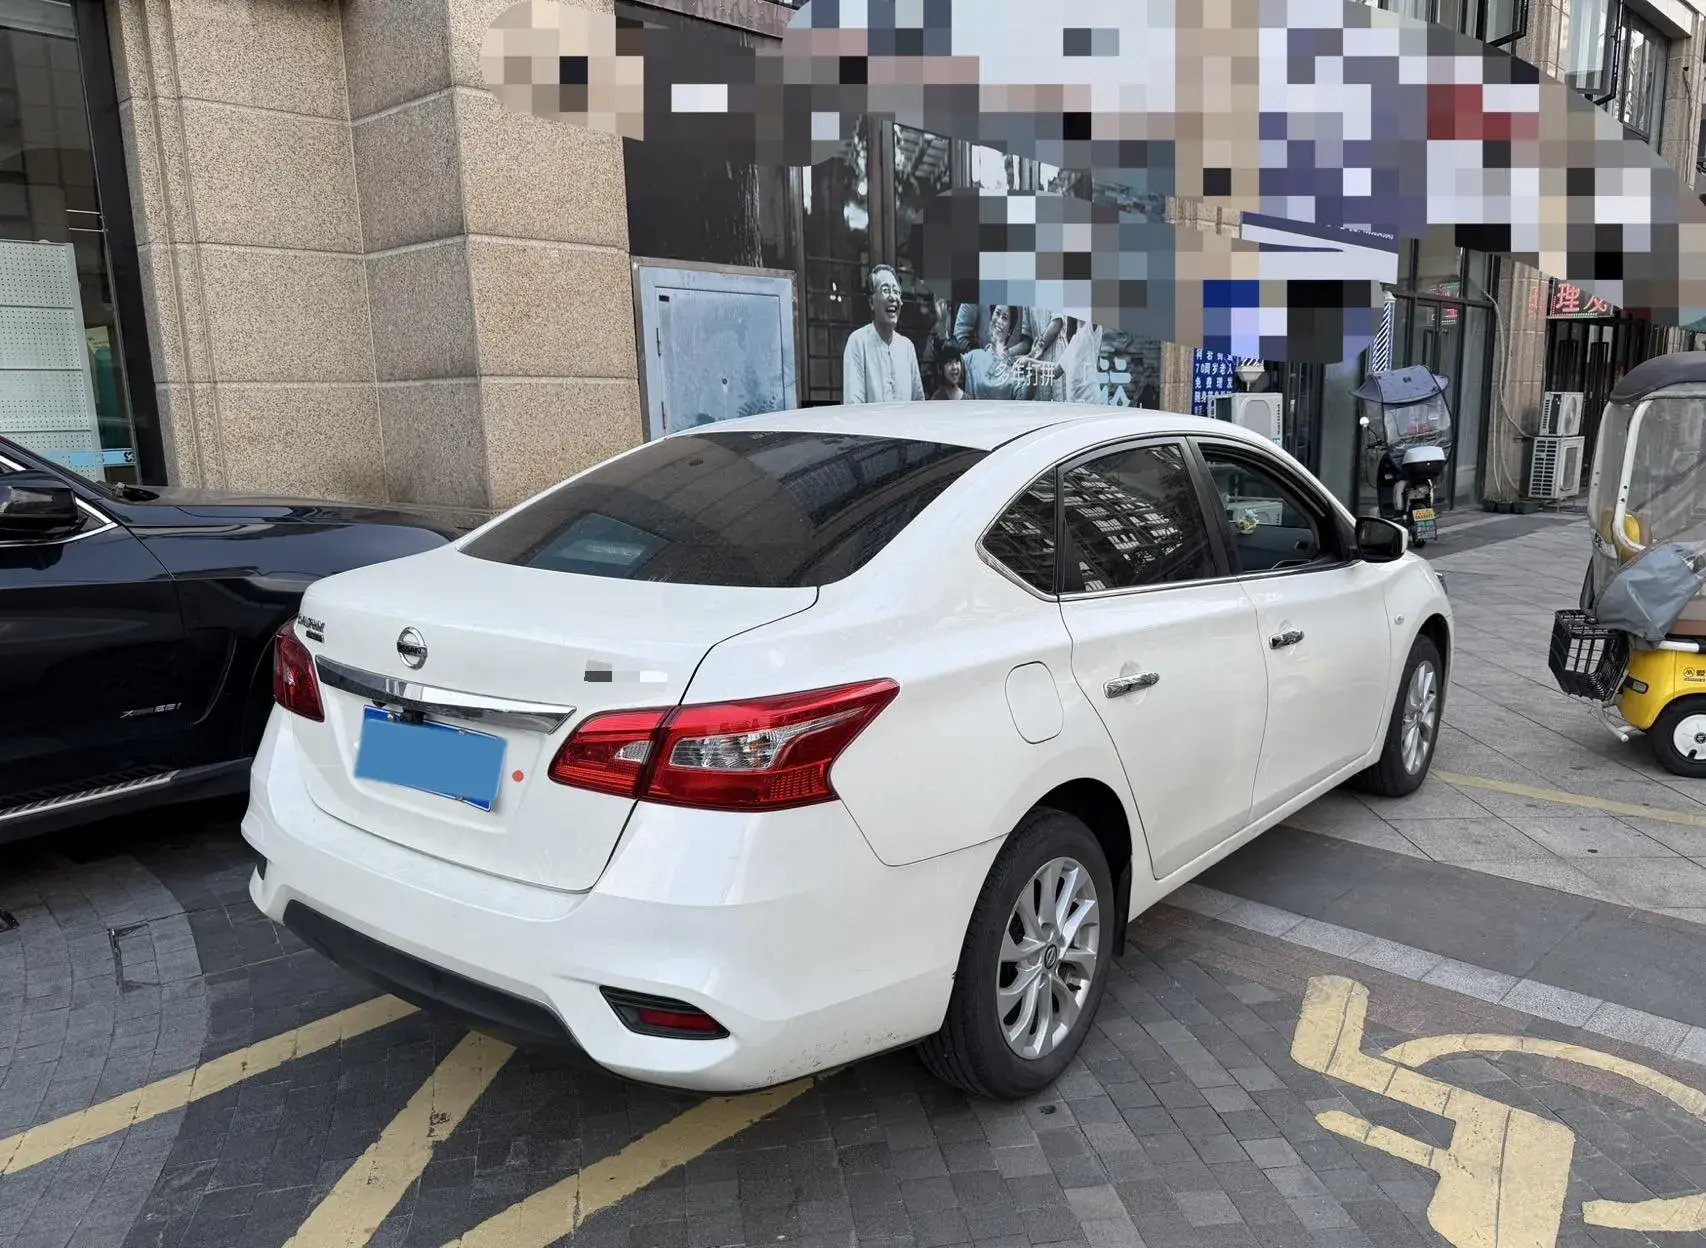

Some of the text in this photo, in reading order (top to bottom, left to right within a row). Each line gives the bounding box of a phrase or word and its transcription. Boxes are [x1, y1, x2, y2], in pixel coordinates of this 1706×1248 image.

[995, 361, 1056, 387] 多年打拼
[1195, 362, 1233, 375] 70周岁老人
[1195, 376, 1233, 389] 免费理发
